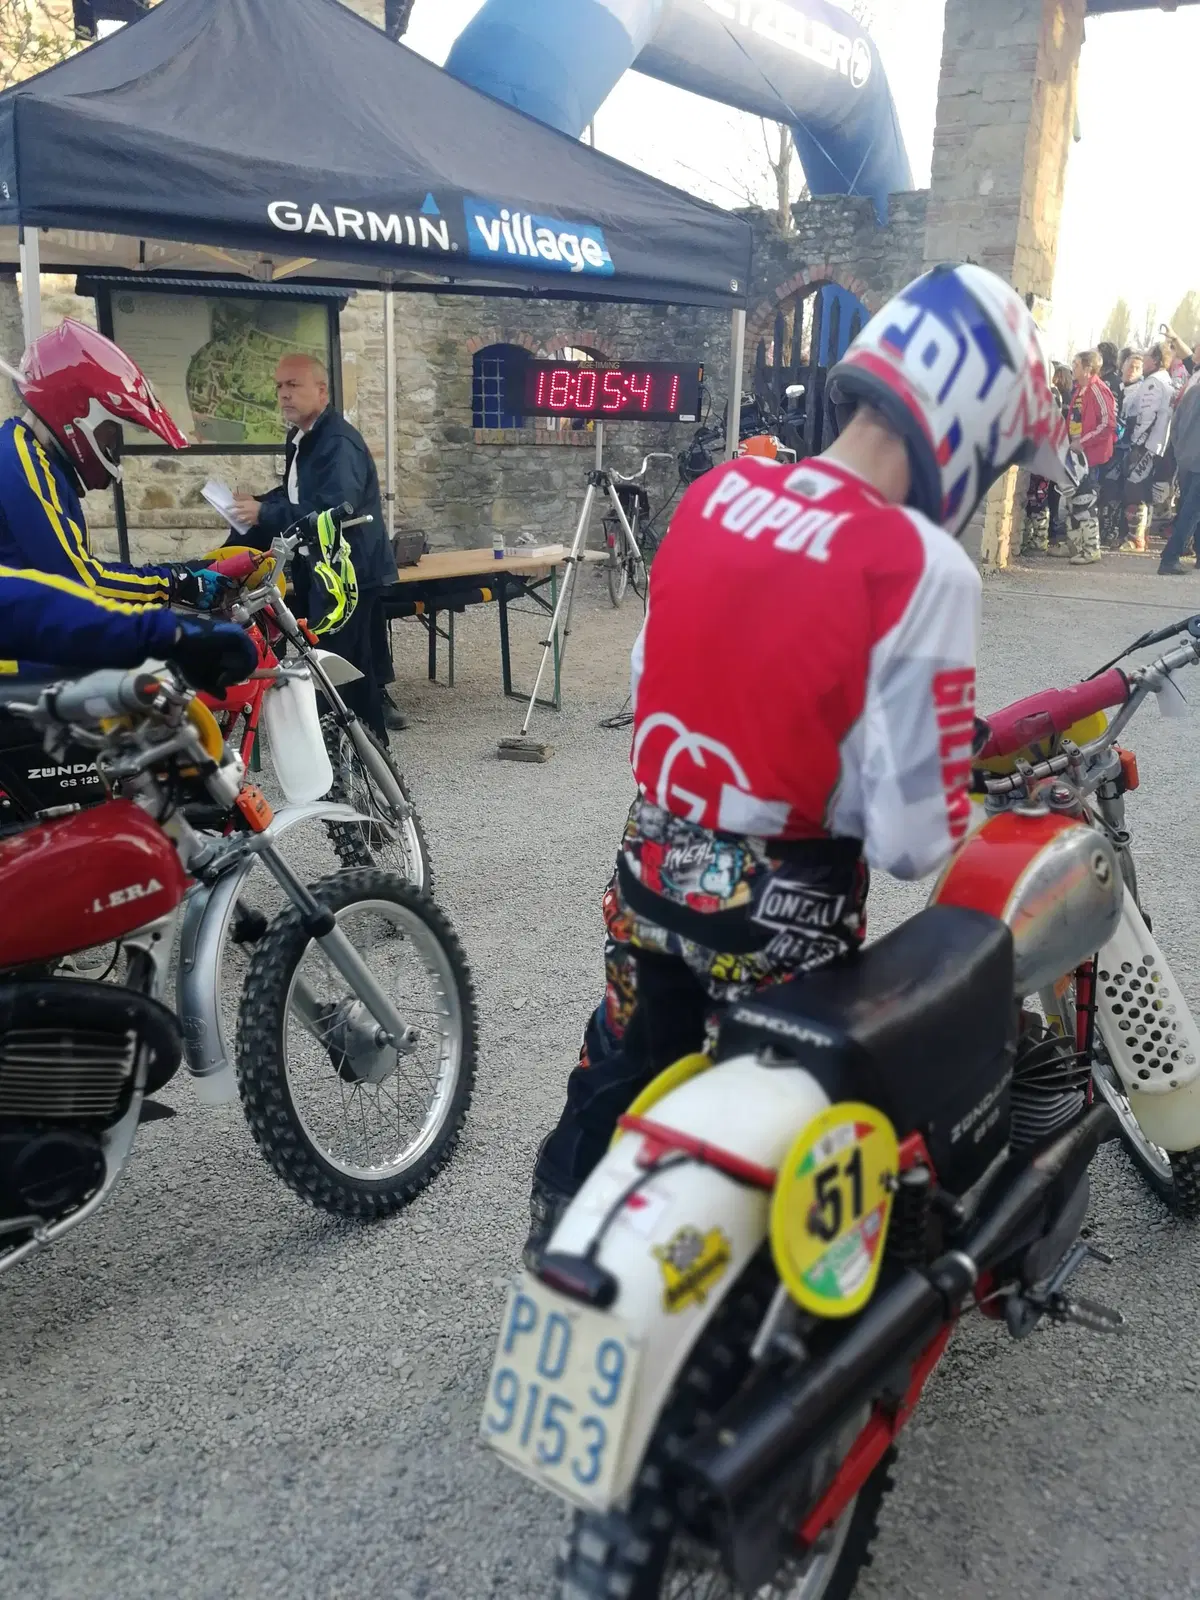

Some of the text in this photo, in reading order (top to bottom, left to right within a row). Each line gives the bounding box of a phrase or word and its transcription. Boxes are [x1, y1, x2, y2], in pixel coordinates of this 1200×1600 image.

[267, 200, 611, 273] GARMIN village
[59, 775, 100, 788] GS 125
[806, 1146, 864, 1244] 51
[503, 1293, 626, 1409] PD 9
[486, 1366, 607, 1486] 9153
